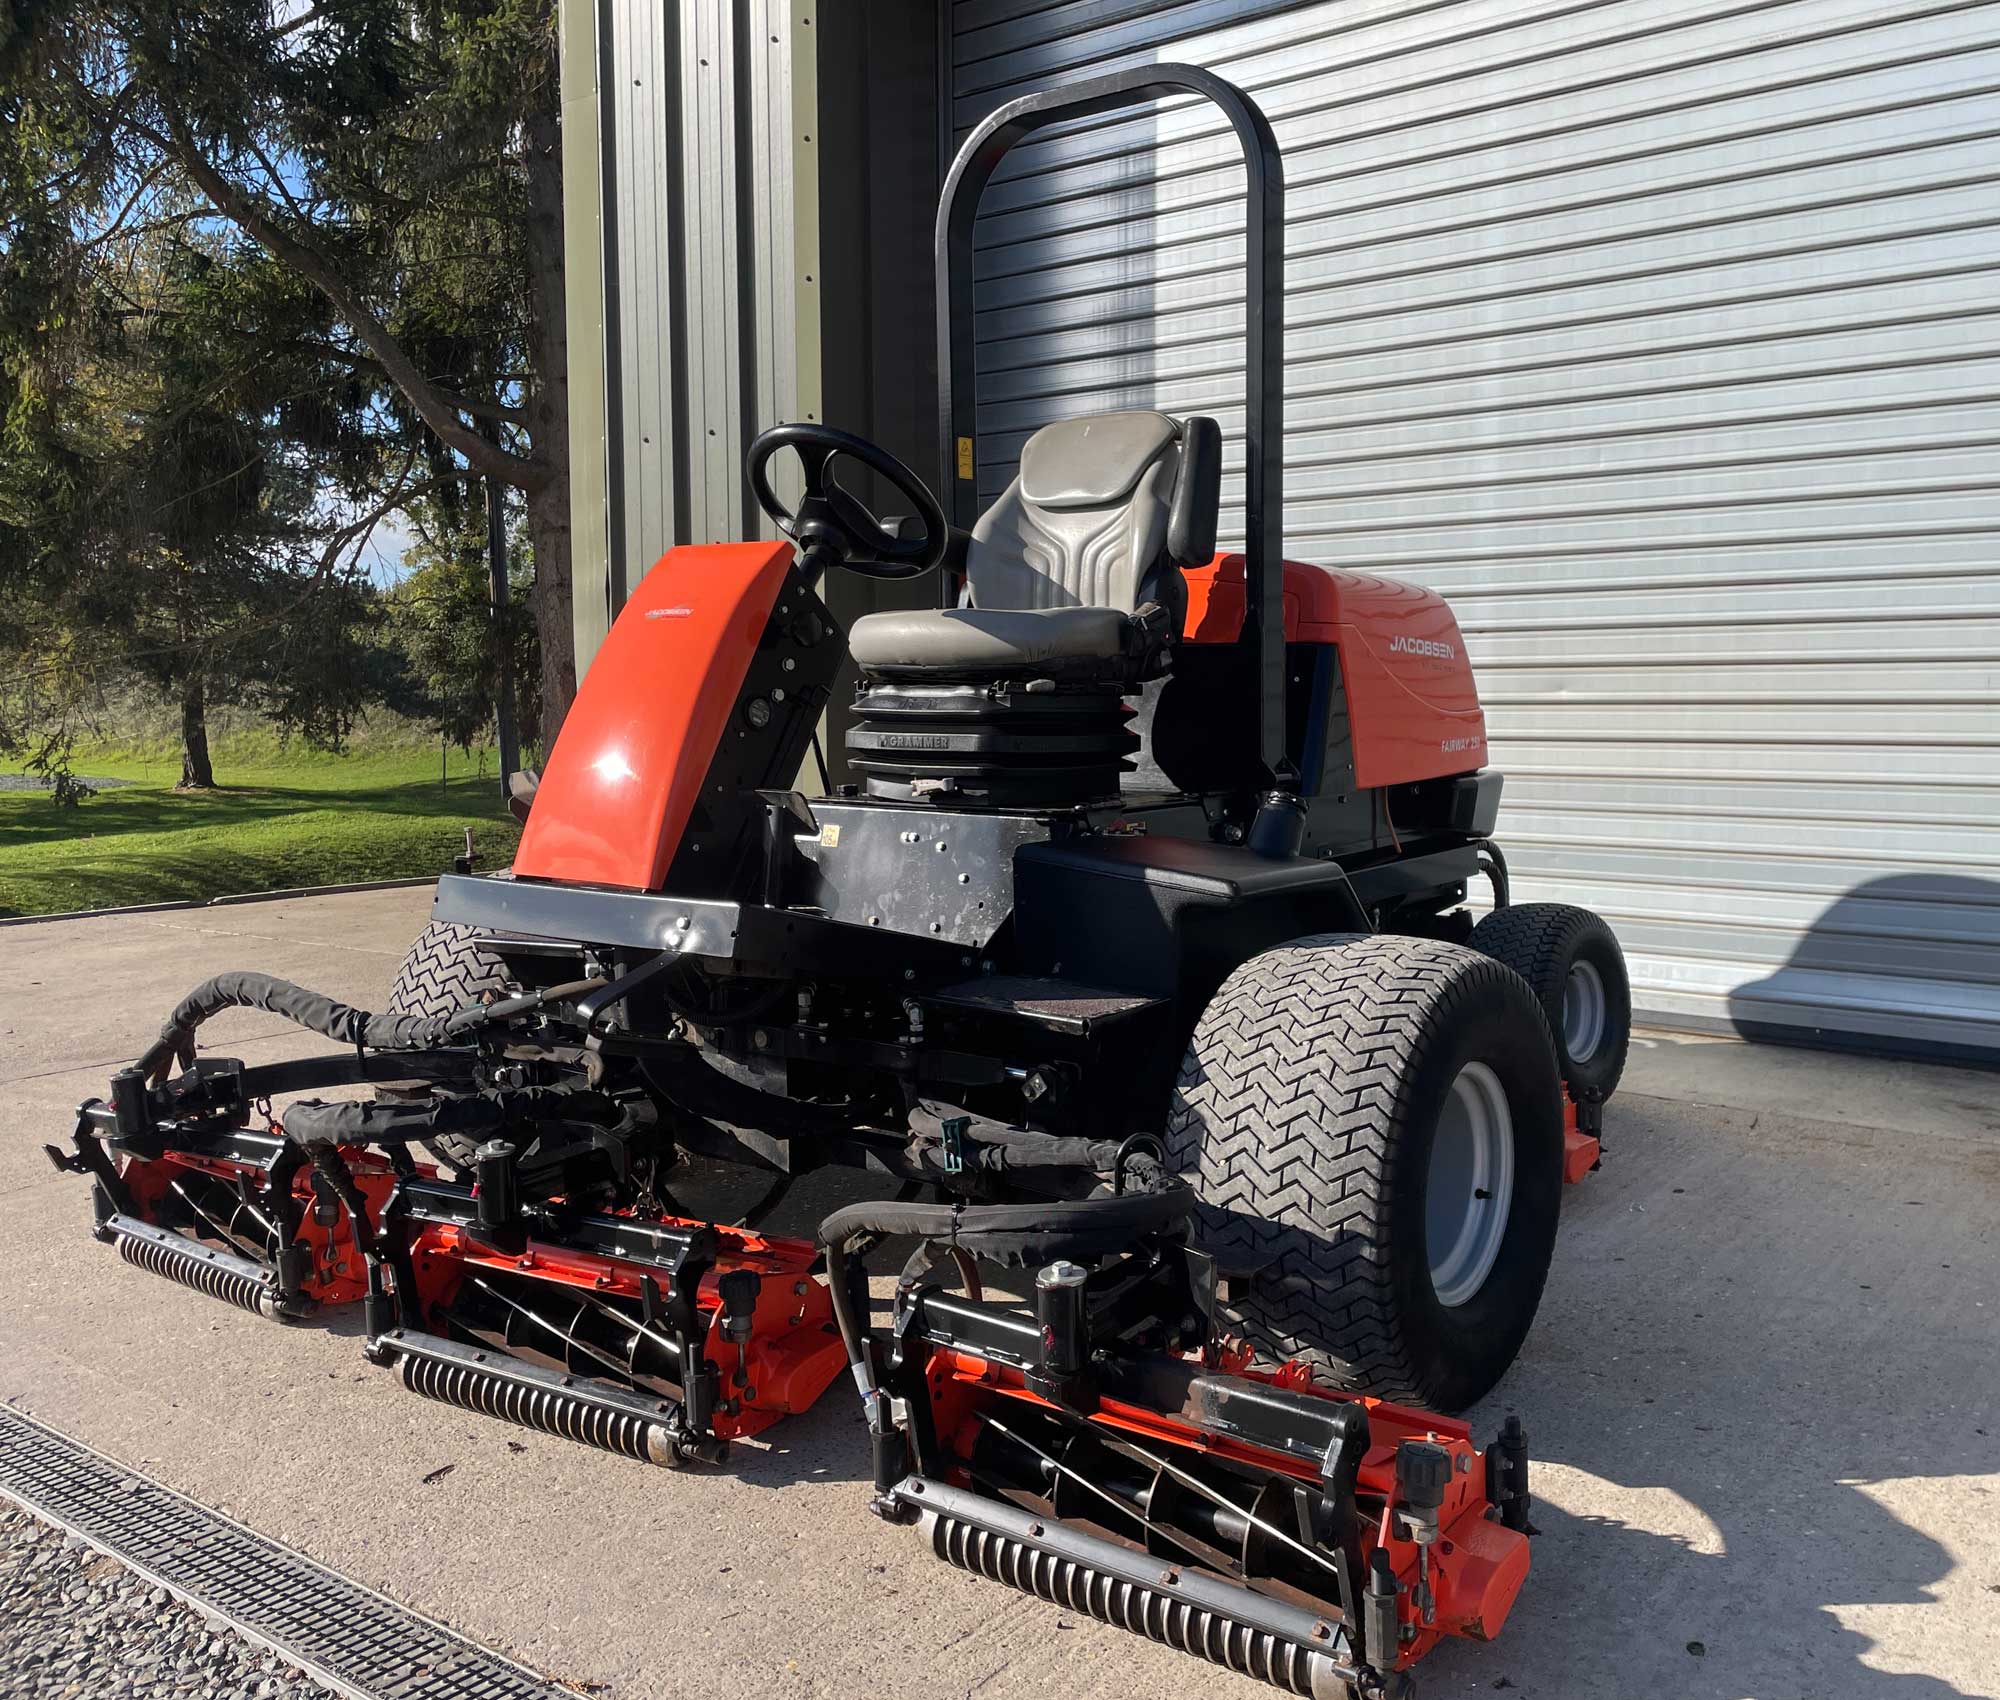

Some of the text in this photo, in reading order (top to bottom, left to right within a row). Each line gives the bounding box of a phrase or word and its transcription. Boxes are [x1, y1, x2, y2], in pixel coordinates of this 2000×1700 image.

[1390, 636, 1454, 660] JACOBSEN
[889, 735, 949, 749] GRAMMER
[1441, 737, 1470, 753] FAIRWAY
